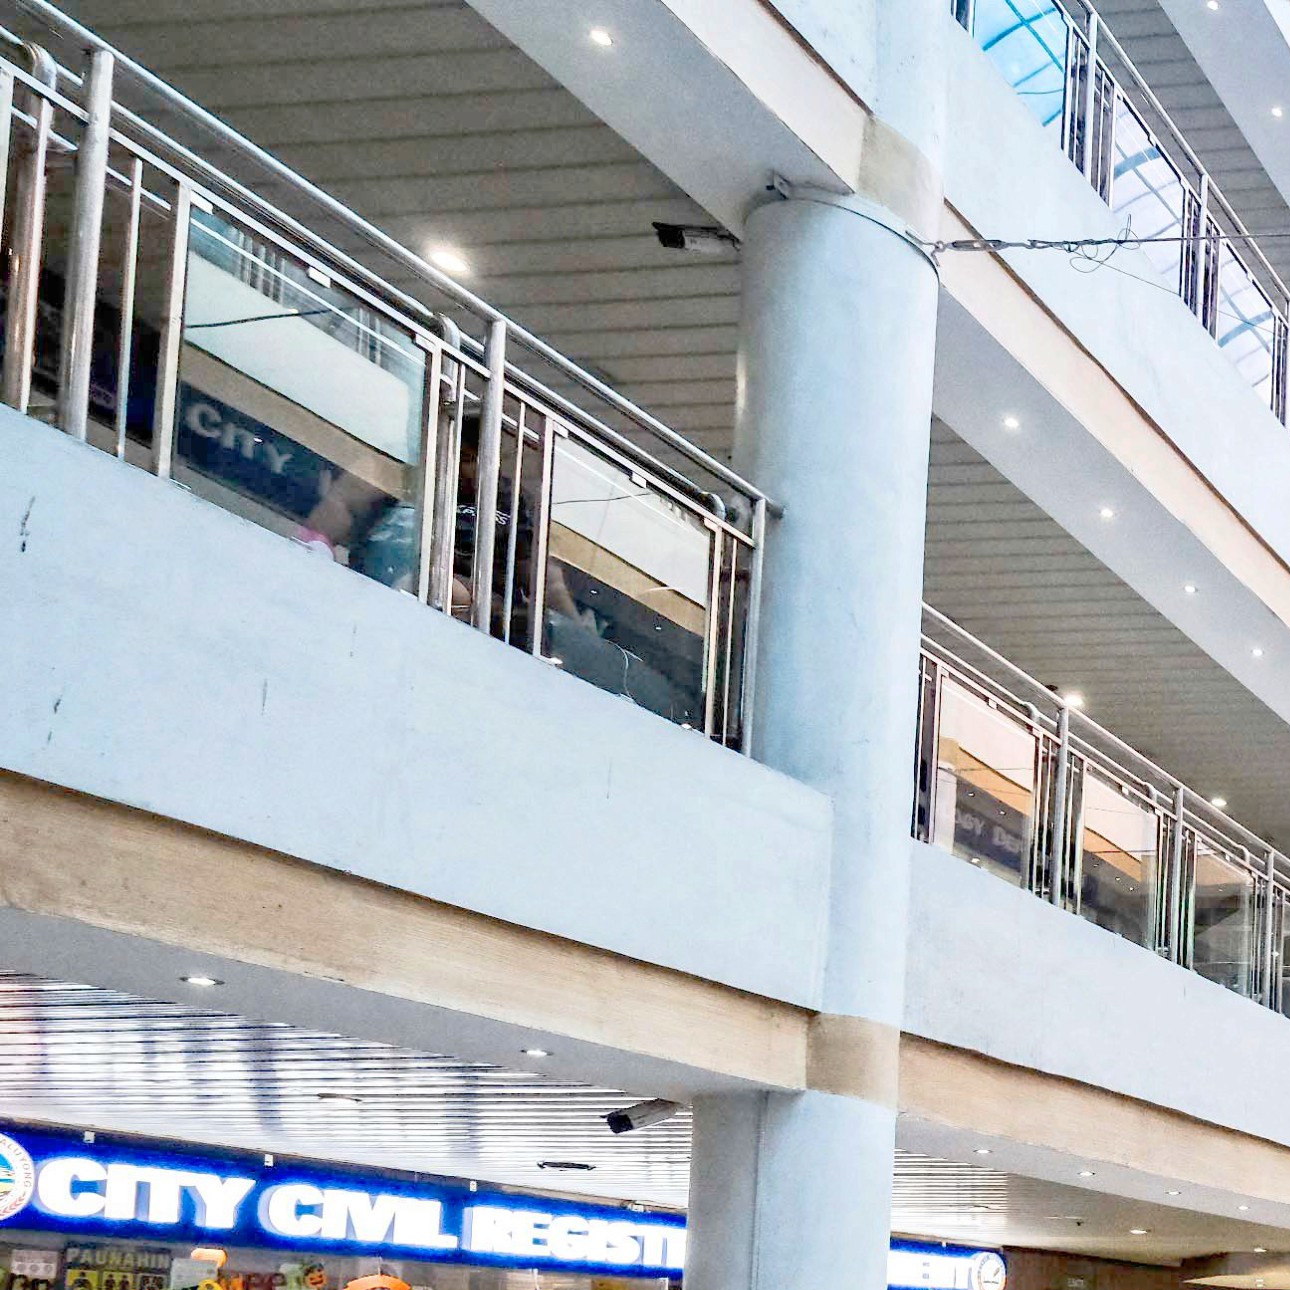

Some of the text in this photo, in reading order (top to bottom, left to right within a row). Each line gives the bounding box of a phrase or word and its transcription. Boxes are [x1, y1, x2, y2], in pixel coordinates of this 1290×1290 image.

[38, 1157, 687, 1269] CITY CIVIL REGIST
